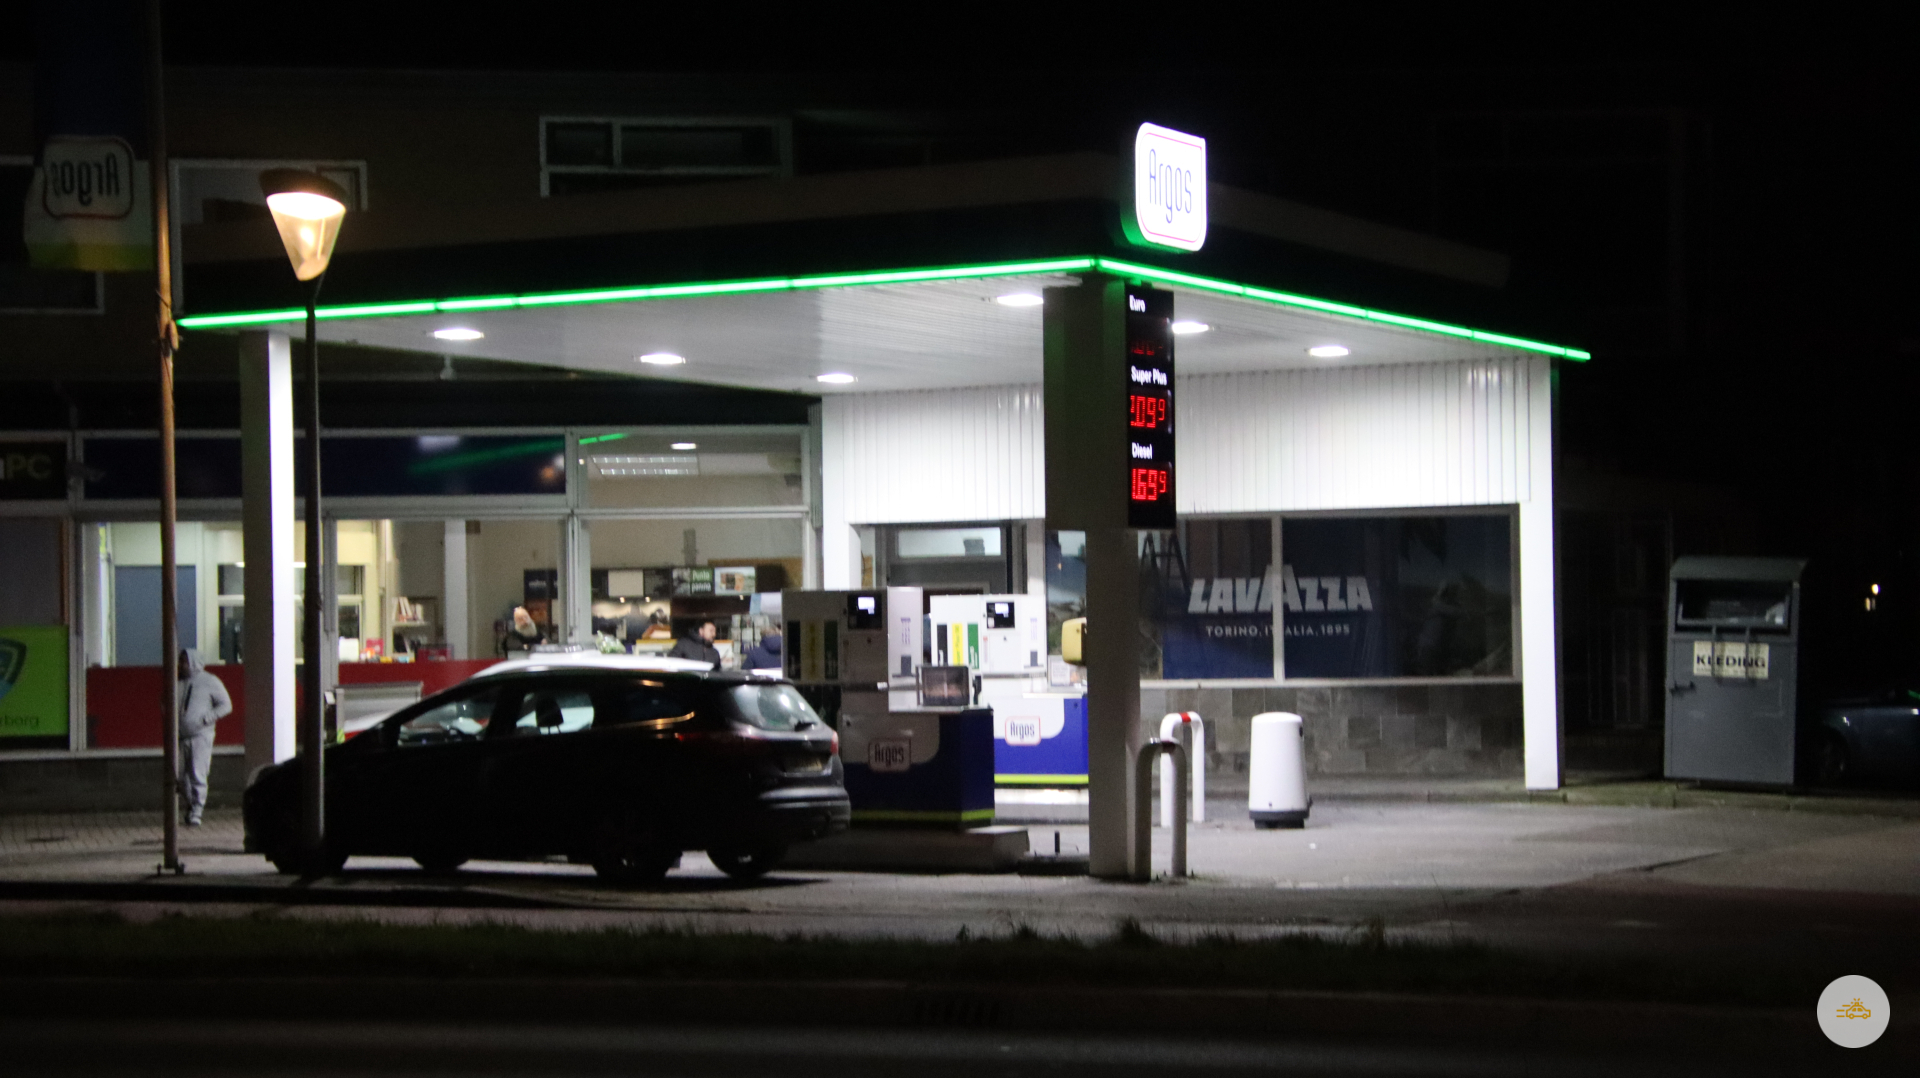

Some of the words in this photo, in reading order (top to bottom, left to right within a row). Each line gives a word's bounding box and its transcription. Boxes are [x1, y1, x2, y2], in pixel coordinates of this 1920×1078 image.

[1149, 148, 1192, 224] Argos
[1129, 294, 1146, 313] Euro
[1131, 365, 1152, 386] Super
[1152, 368, 1168, 386] Plus
[1131, 441, 1153, 460] Diesel
[1188, 564, 1373, 614] LAVAZZA
[1696, 655, 1766, 668] KLEDING
[1010, 720, 1035, 742] Argos
[874, 743, 904, 767] Argos
